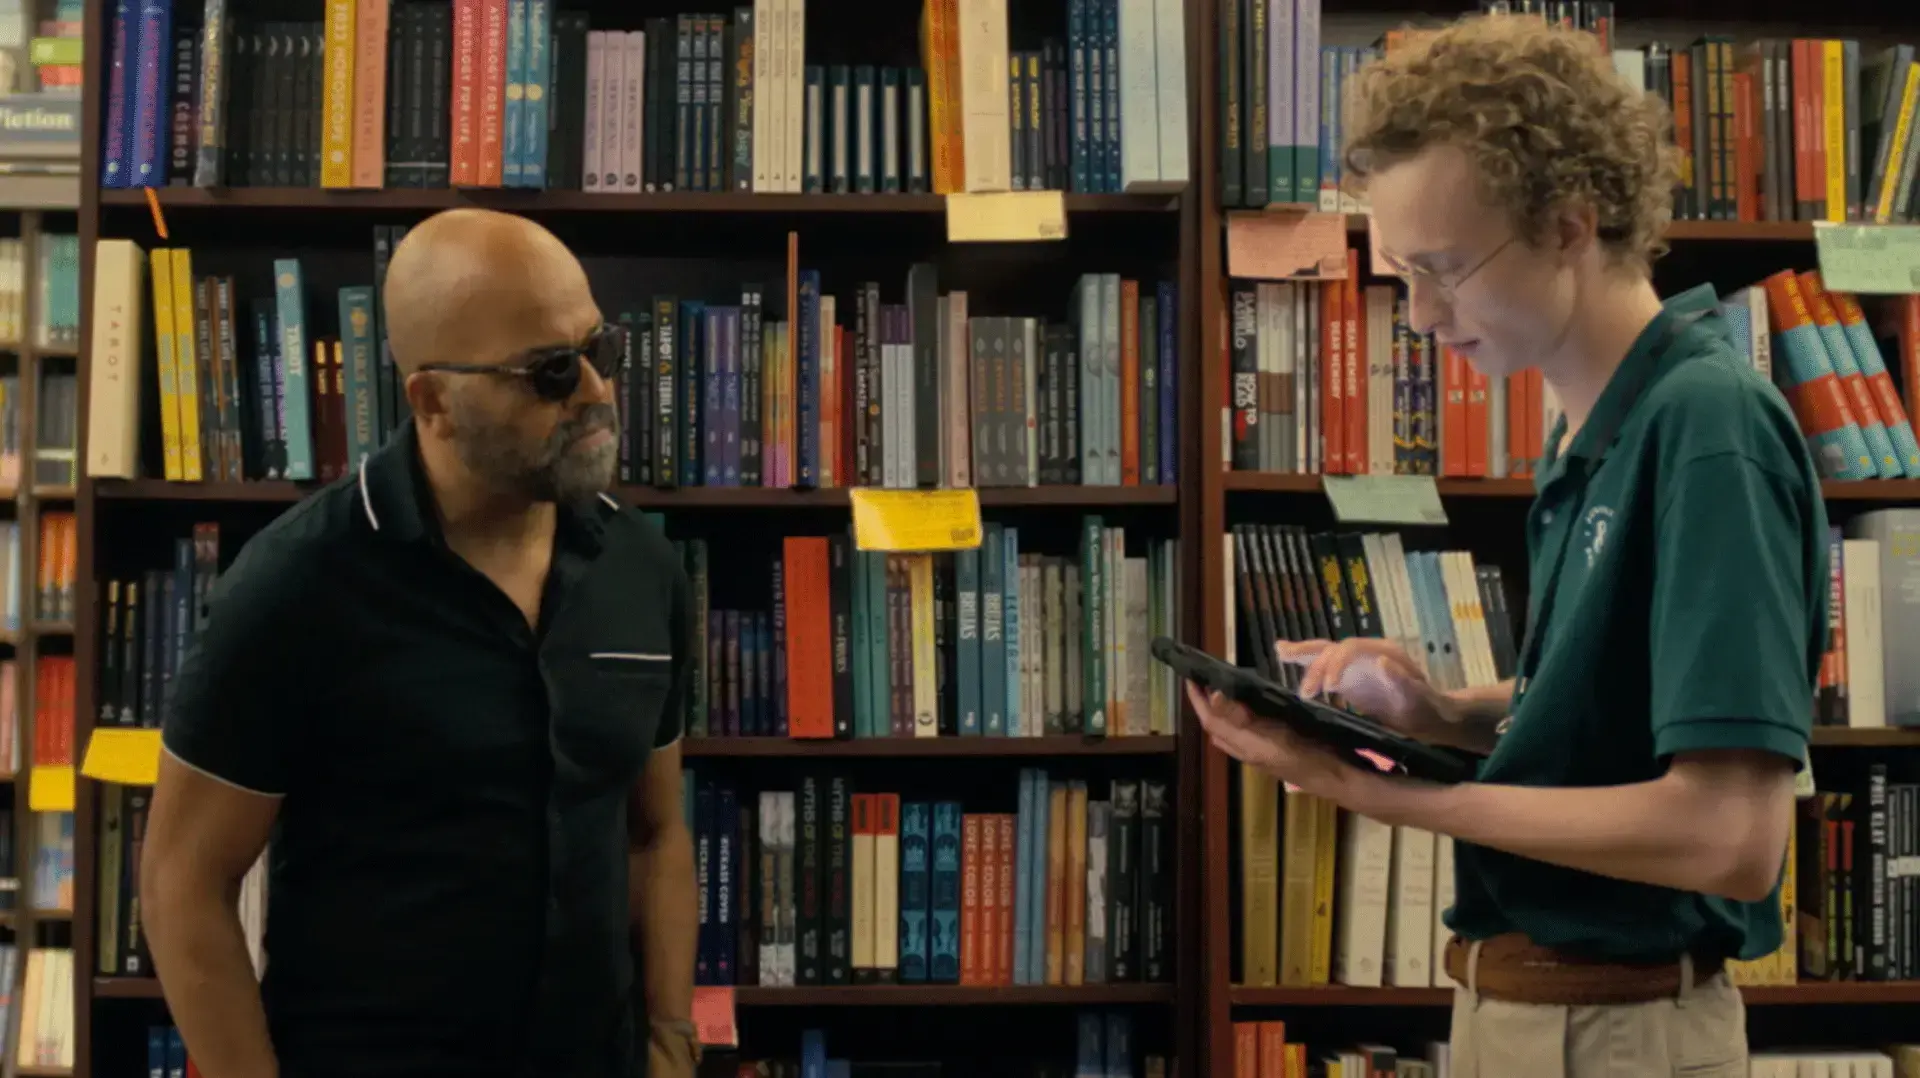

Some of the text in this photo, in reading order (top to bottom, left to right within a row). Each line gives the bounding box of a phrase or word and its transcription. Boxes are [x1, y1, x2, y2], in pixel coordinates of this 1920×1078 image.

[172, 38, 193, 169] QUEEN COSMOS
[331, 46, 347, 143] HOROSCOPE
[459, 5, 473, 143] ASTROLOGY FOR LIFE
[486, 5, 499, 143] ASTROLOGY FOR LIFE
[0, 106, 75, 130] iction
[107, 304, 123, 382] TAROT
[286, 323, 302, 377] TAROT
[659, 325, 673, 415] TAROT TEQUILA
[1331, 320, 1341, 399] DEAR MEMORY
[1346, 319, 1357, 397] DEAR MEMORY
[960, 591, 977, 641] BRUJAS
[984, 591, 1001, 641] BRUJAS
[804, 777, 817, 823] MYTHS
[831, 777, 845, 823] MYTHS
[1871, 775, 1886, 806] PHIL
[1871, 811, 1886, 845] KLAY
[965, 819, 977, 908] LOVE COLOR
[983, 819, 995, 908] LOVE COLOR
[1000, 819, 1012, 908] LOVE COLOR
[718, 885, 730, 924] COVEN
